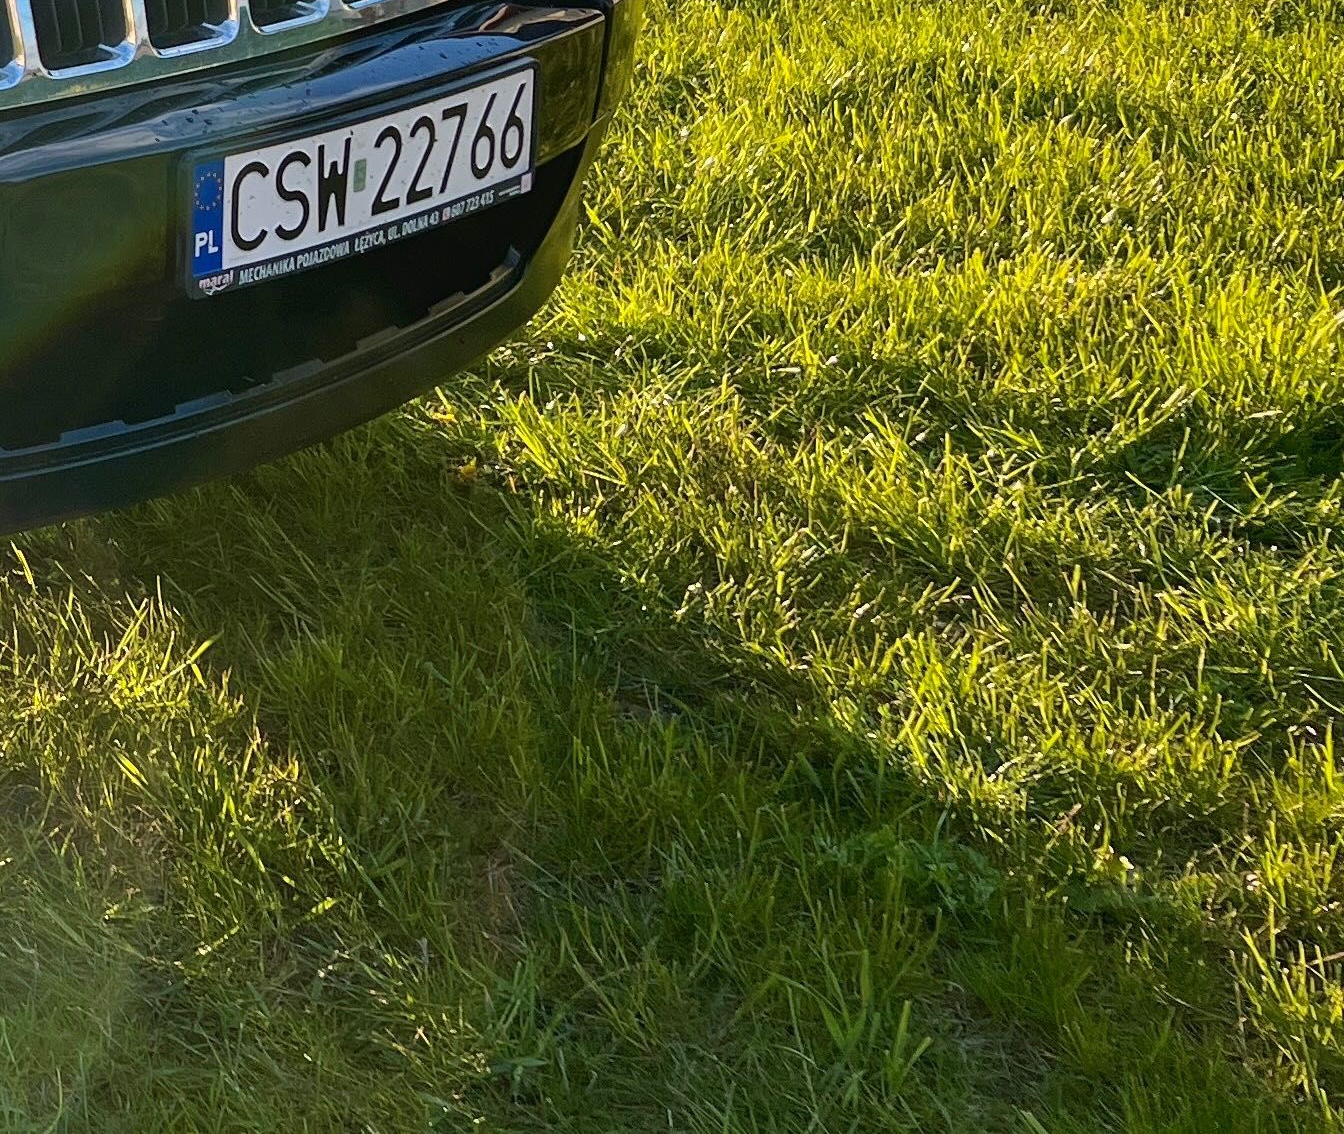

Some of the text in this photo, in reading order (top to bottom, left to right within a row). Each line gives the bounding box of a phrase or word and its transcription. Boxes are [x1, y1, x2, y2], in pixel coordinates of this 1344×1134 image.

[230, 82, 527, 251] CSW 22766
[194, 229, 219, 258] PL
[238, 257, 295, 285] MECHANIKA
[297, 241, 350, 268] POJAZDOWA
[388, 228, 401, 241] UL.
[198, 271, 234, 291] maral
